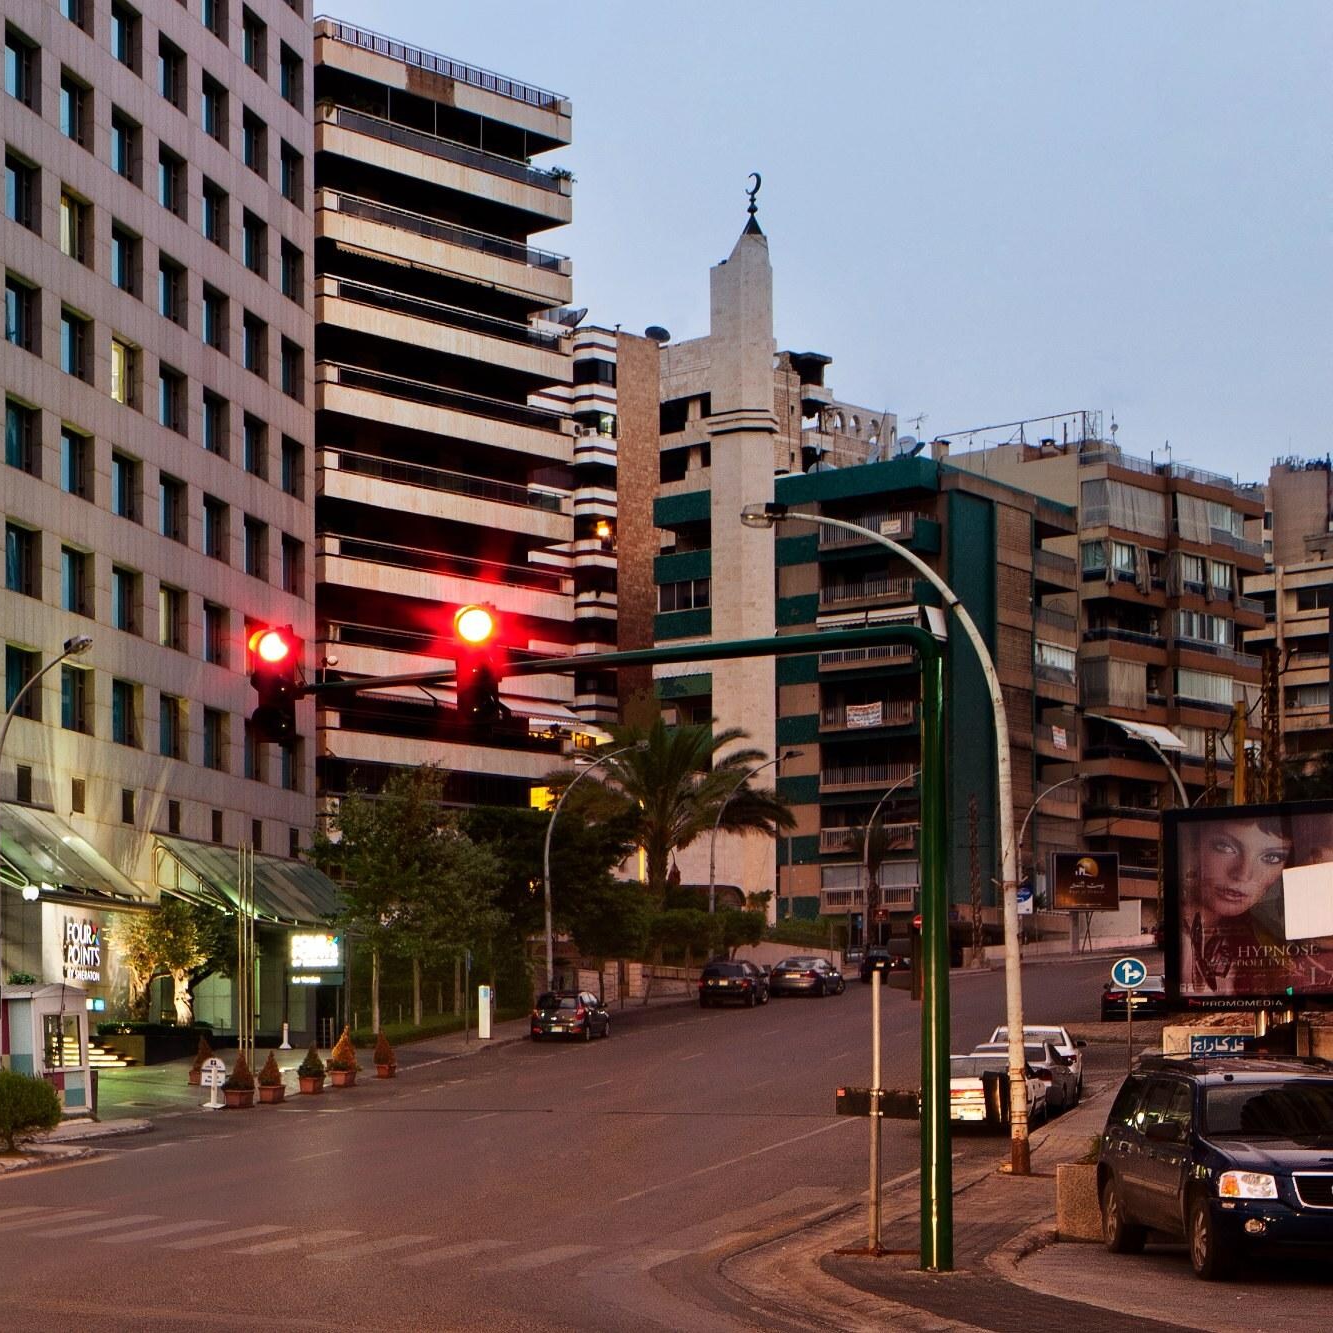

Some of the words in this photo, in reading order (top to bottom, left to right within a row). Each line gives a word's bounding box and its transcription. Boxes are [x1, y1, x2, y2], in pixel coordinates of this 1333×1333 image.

[67, 921, 94, 945] FOUR
[67, 944, 101, 967] POINTS
[75, 970, 100, 982] SHERATON
